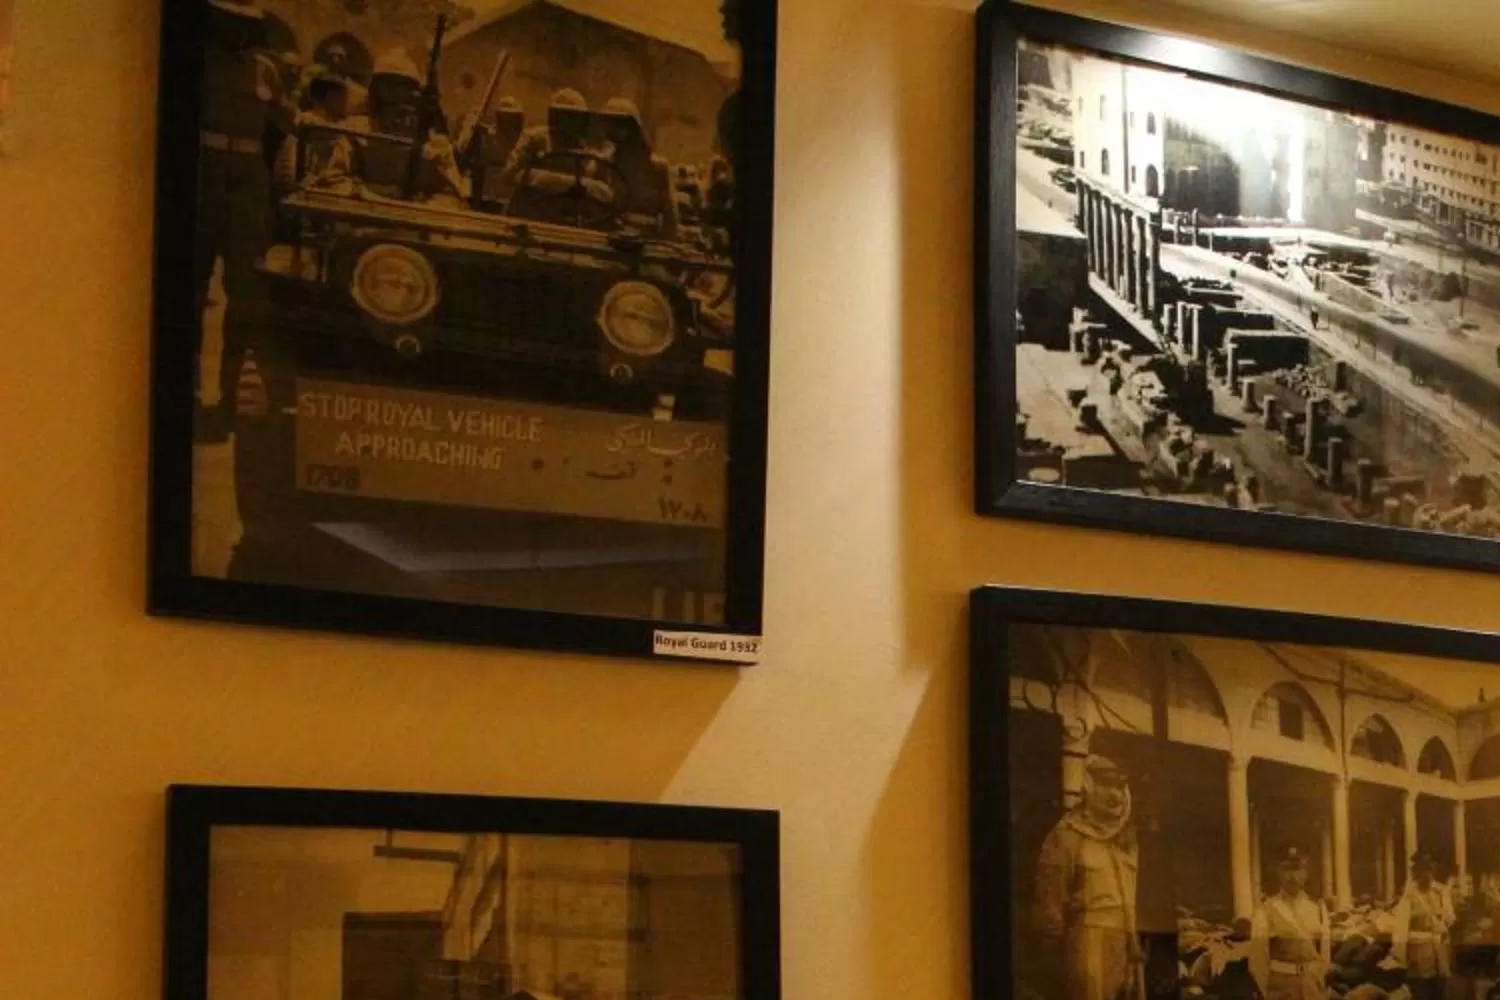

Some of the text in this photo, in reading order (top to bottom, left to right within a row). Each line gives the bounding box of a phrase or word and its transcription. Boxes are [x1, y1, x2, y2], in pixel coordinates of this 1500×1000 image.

[300, 391, 545, 443] STOP ROYAL VEHICLE
[335, 430, 505, 471] APPROACHING
[655, 634, 687, 649] Royal
[690, 637, 727, 651] Guard
